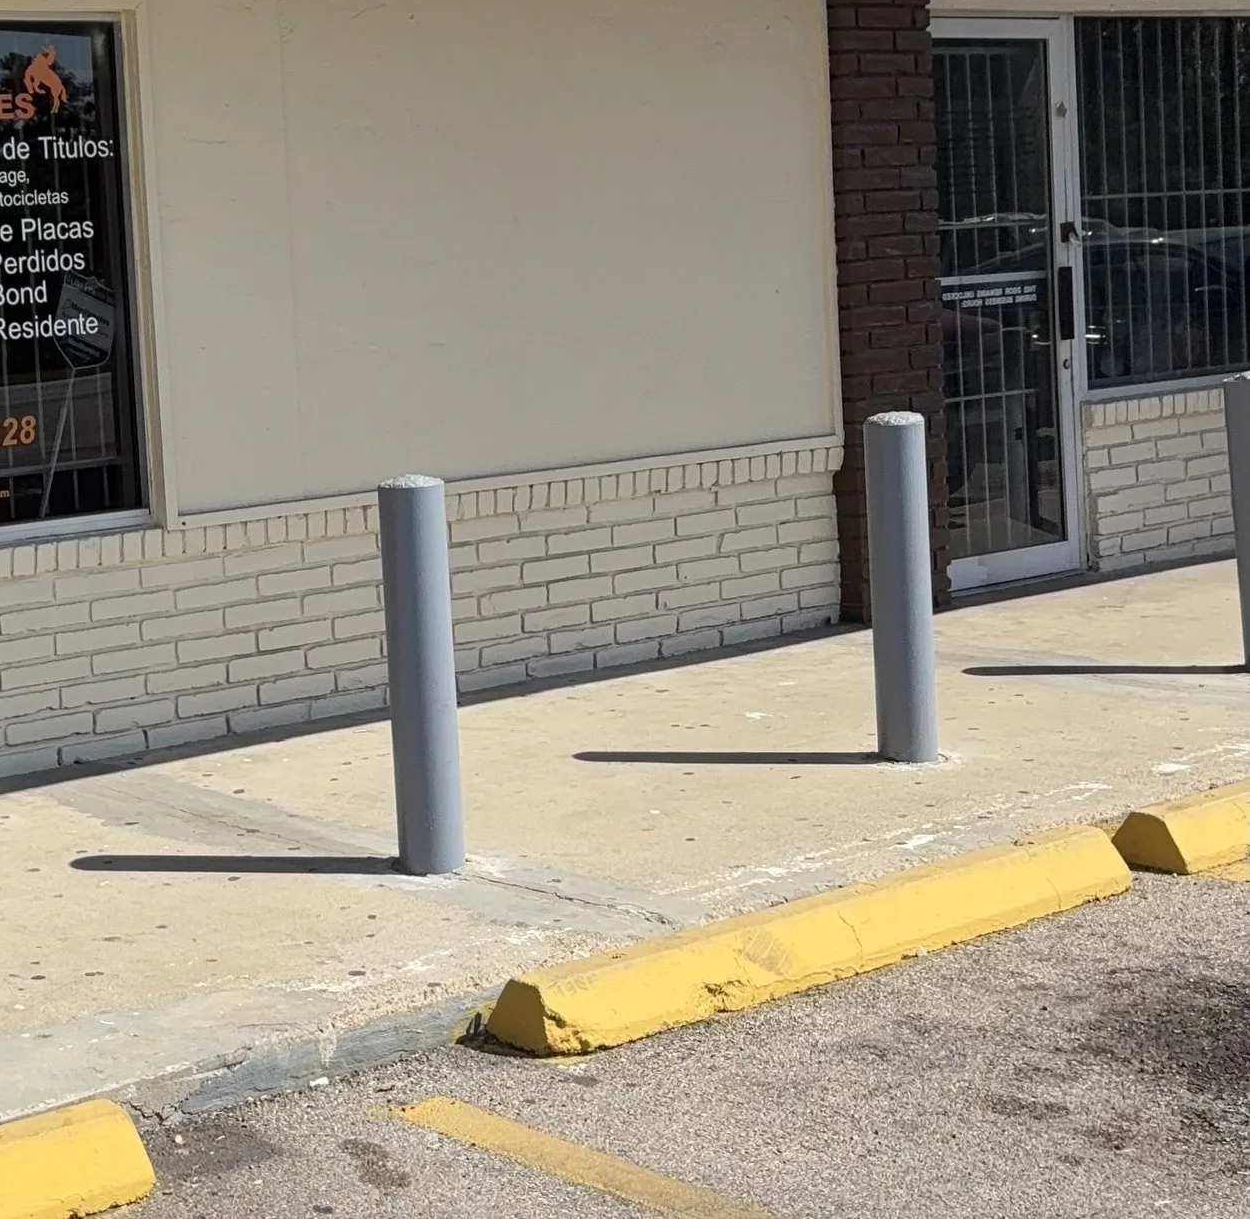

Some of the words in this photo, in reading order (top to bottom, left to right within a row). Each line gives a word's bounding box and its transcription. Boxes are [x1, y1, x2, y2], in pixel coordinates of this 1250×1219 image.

[2, 136, 30, 160] de
[37, 135, 114, 159] Titulos:
[21, 217, 94, 242] Placas
